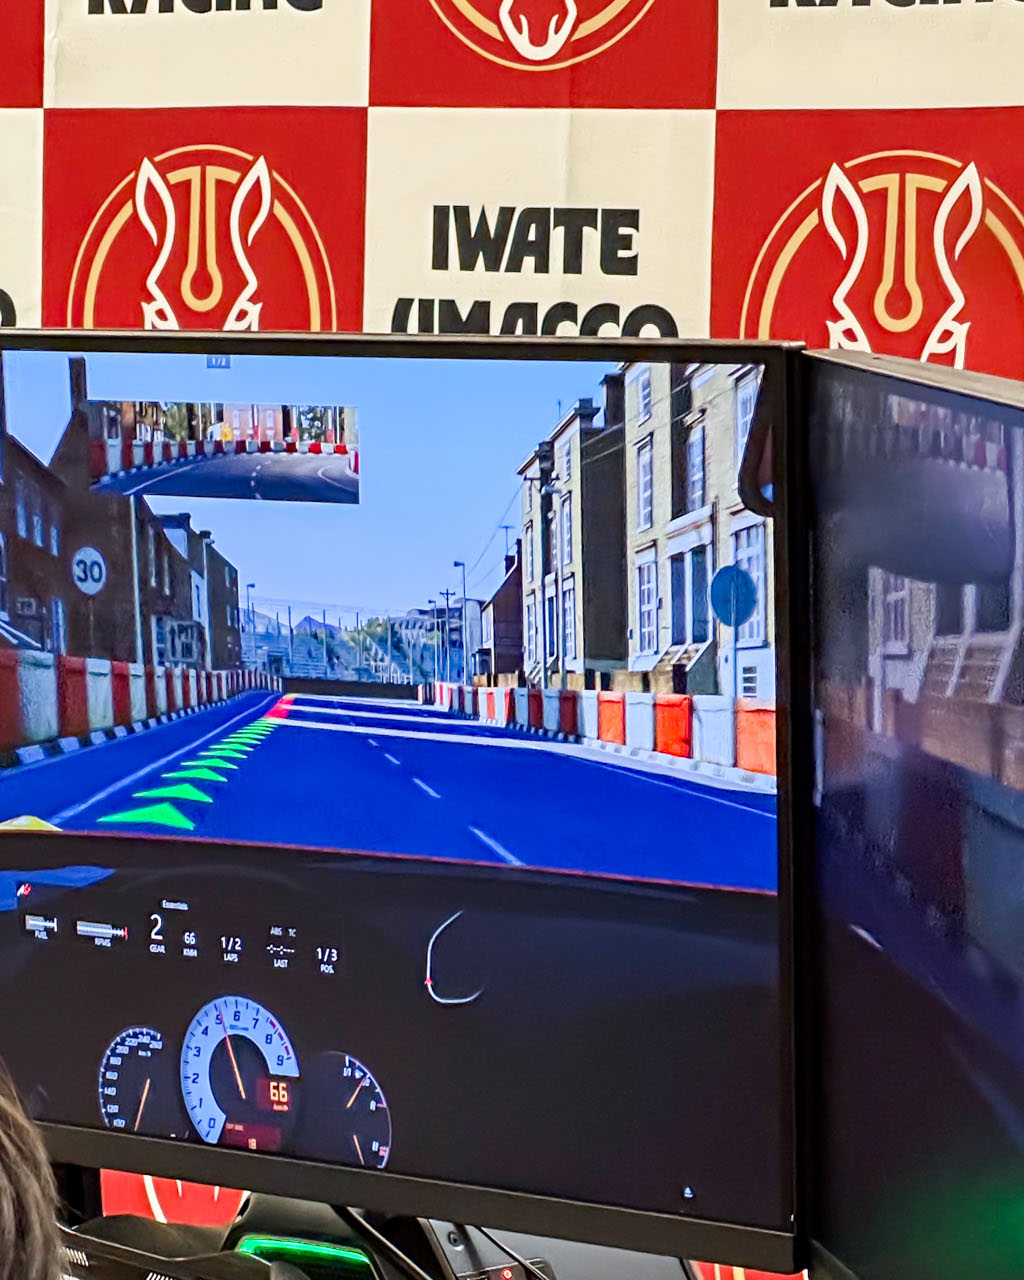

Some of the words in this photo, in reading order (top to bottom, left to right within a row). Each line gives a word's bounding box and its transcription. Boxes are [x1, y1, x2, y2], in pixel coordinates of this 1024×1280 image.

[432, 205, 640, 276] IWATE
[75, 559, 103, 584] 30
[150, 913, 164, 941] 2
[183, 931, 196, 945] 66
[220, 936, 242, 951] 1/2
[149, 943, 167, 954] GEAR
[316, 947, 338, 962] 1/3
[223, 953, 239, 963] LAPS
[273, 958, 289, 968] LAST
[233, 1010, 241, 1022] 6
[252, 1017, 260, 1030] 7
[201, 1025, 209, 1037] 4
[265, 1033, 273, 1045] 8
[193, 1046, 201, 1058] 3
[276, 1054, 284, 1066] 9
[191, 1072, 200, 1084] 2
[269, 1081, 288, 1102] 66
[208, 1117, 216, 1129] 0
